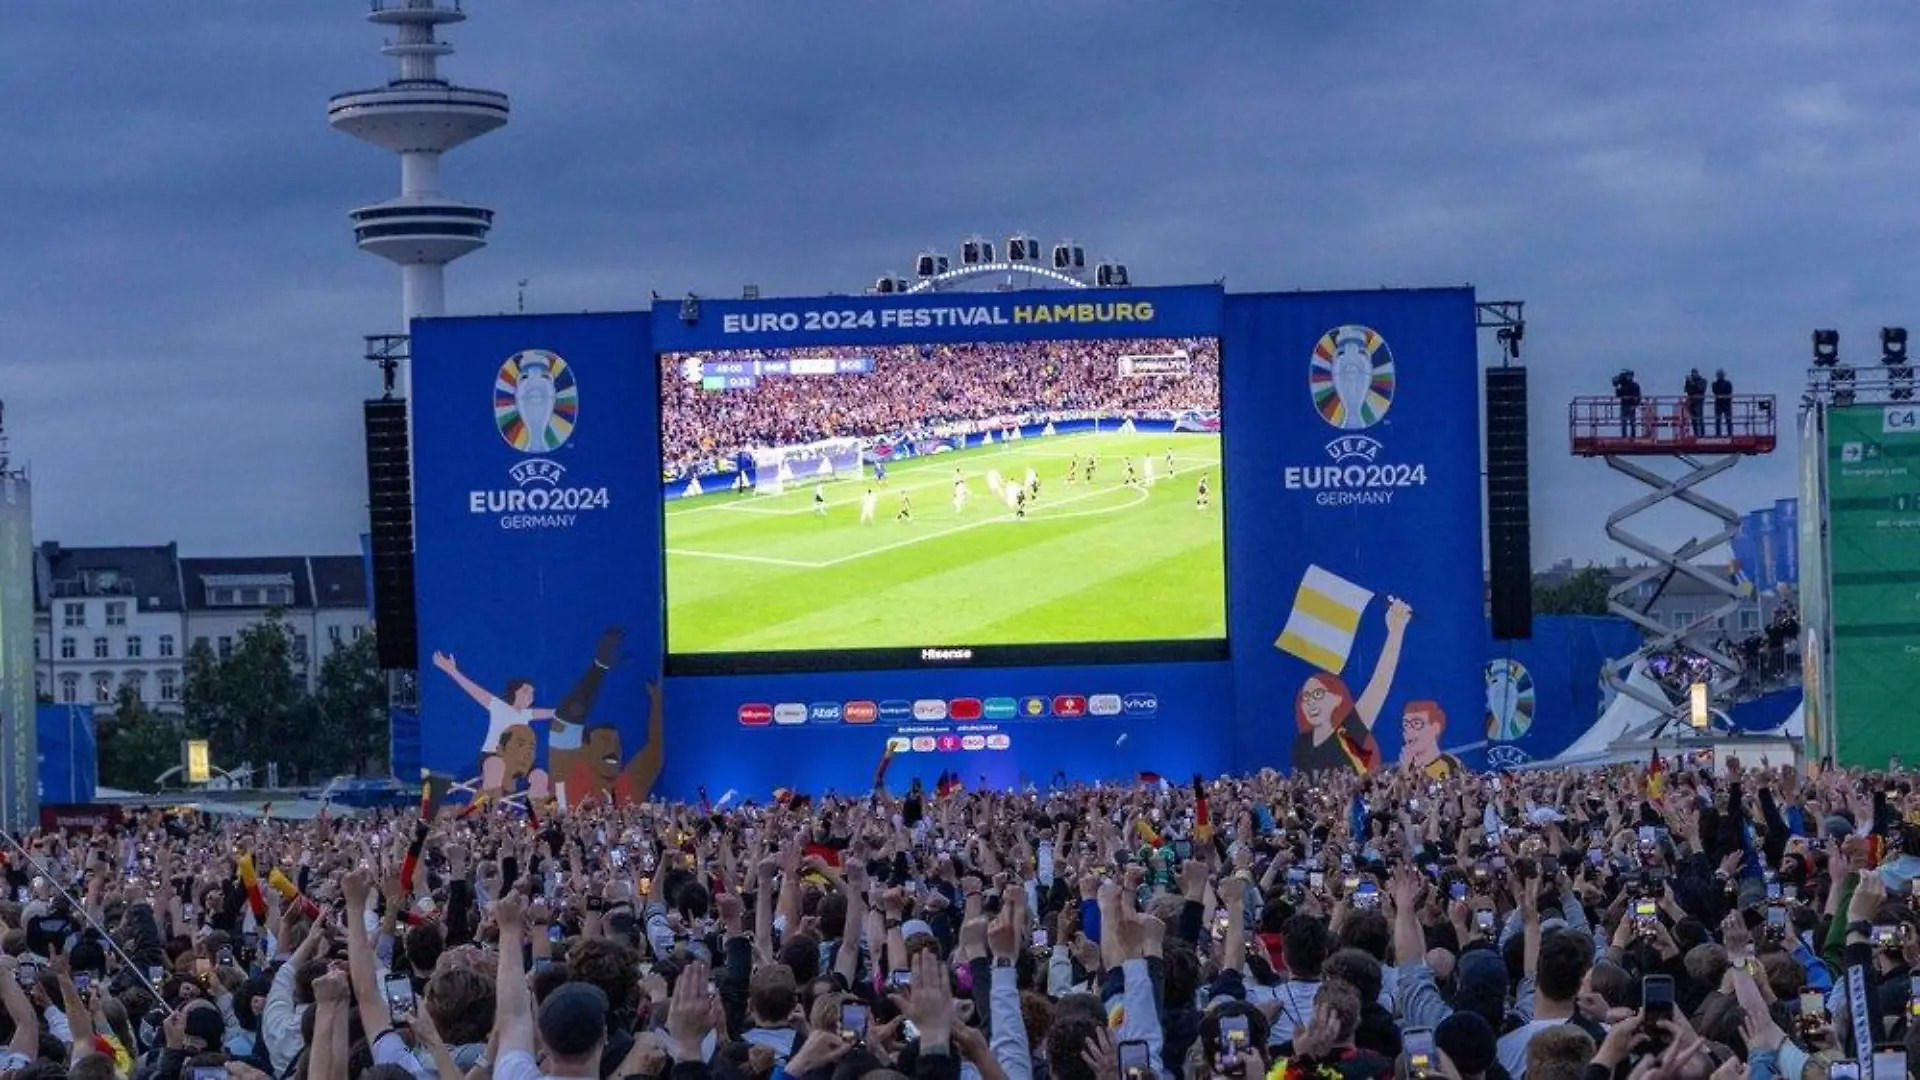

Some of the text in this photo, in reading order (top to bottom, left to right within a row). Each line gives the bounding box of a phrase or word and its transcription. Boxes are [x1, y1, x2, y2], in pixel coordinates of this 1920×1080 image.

[723, 303, 1155, 334] EURO 2024 FESTIVAL HAMBURG
[1888, 411, 1916, 428] C4
[1327, 439, 1378, 459] UEFA
[512, 463, 561, 483] UEFA
[1284, 464, 1427, 489] EURO2024
[469, 487, 610, 513] EURO2024
[1316, 491, 1394, 506] GERMANY
[500, 514, 577, 529] GERMANY
